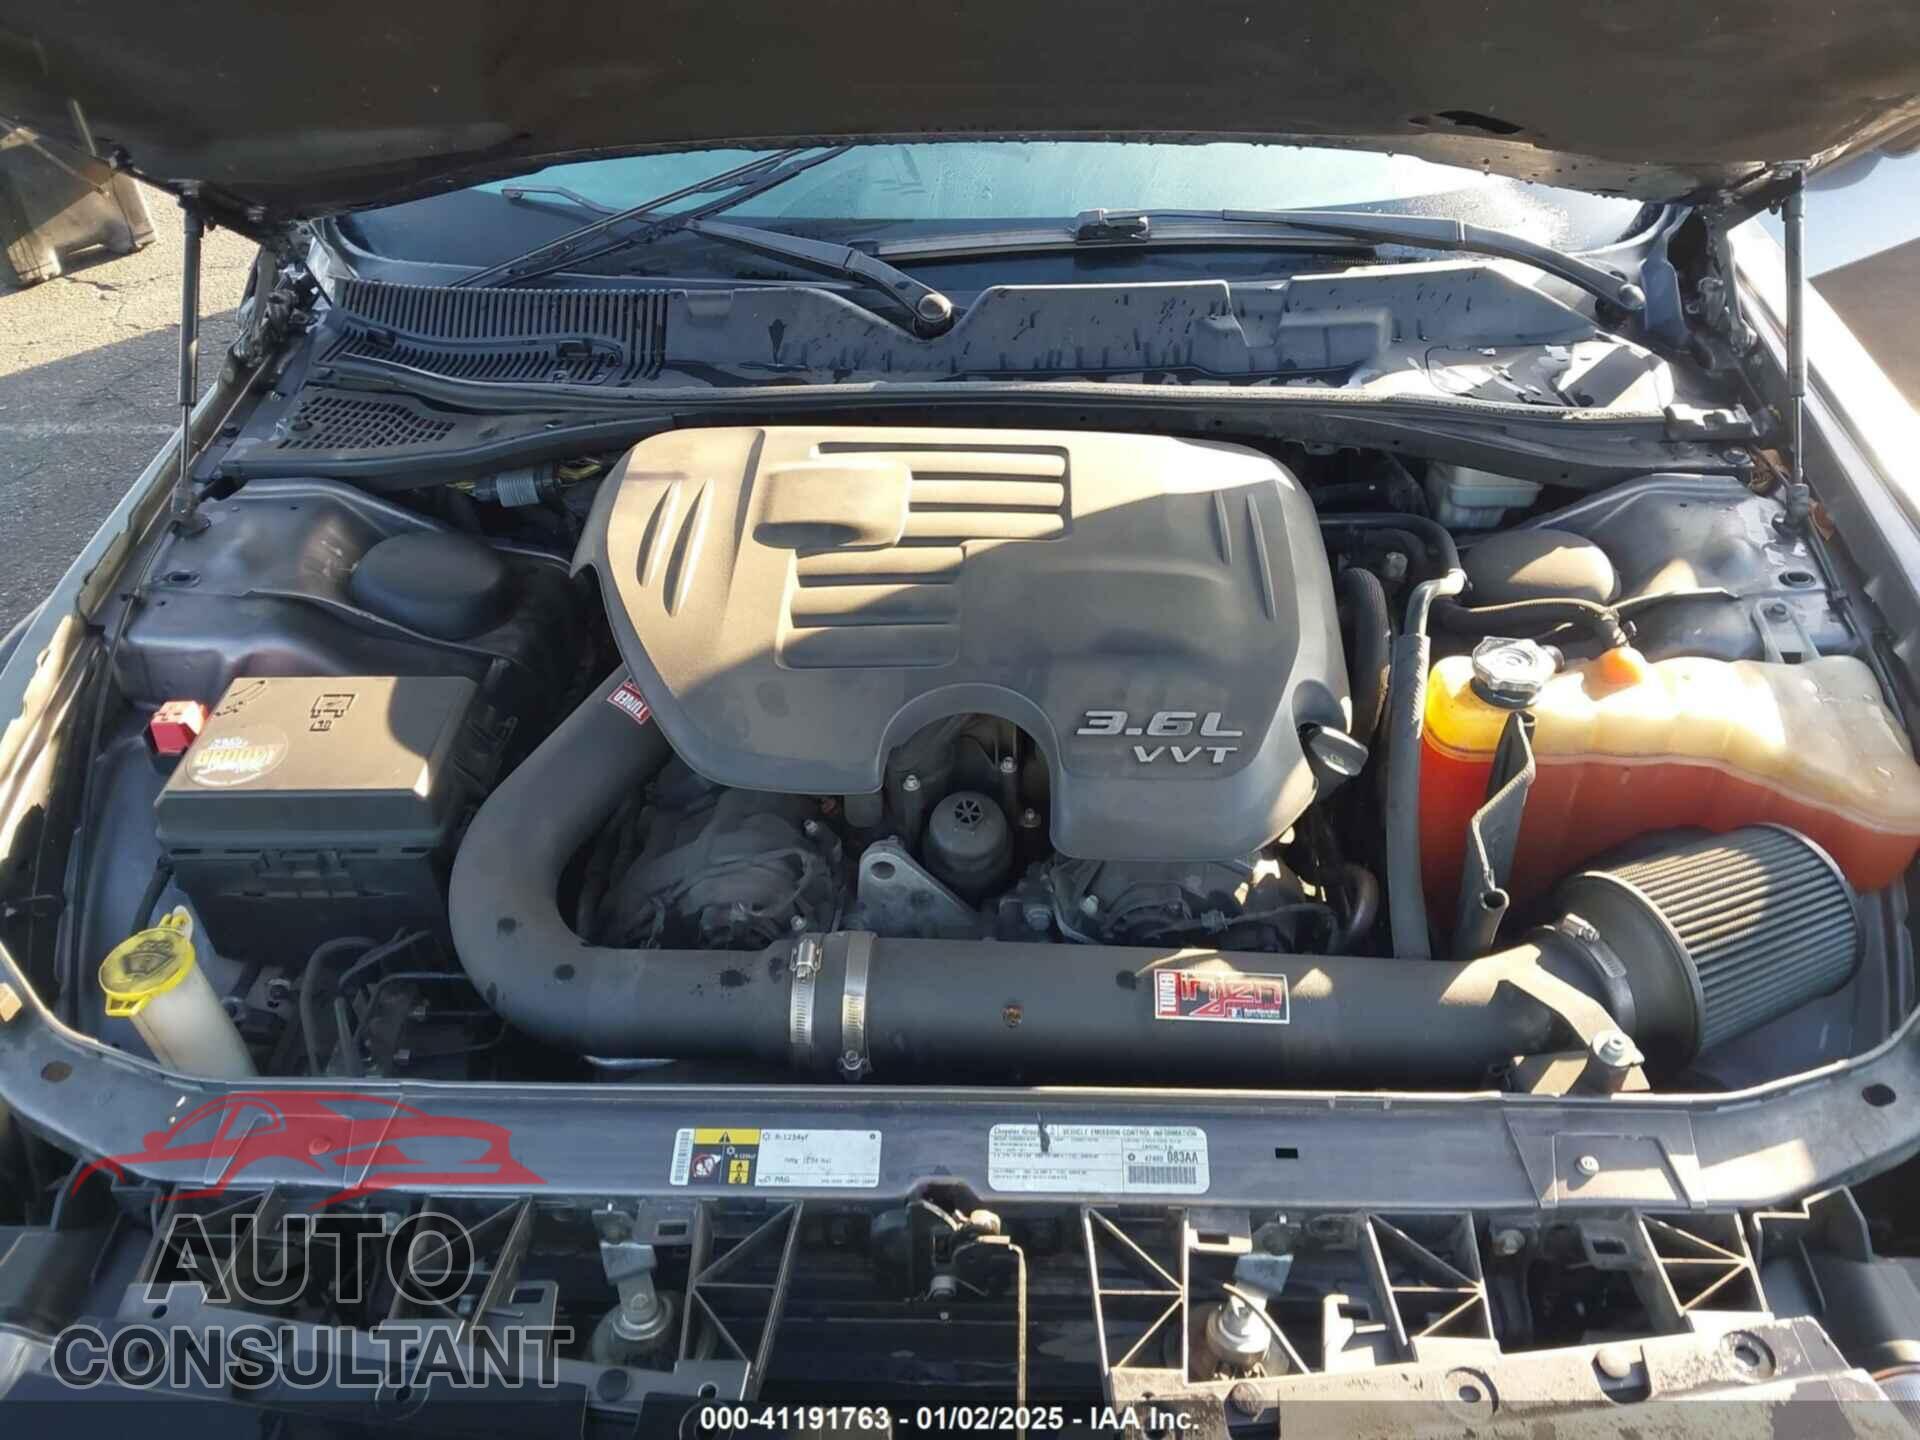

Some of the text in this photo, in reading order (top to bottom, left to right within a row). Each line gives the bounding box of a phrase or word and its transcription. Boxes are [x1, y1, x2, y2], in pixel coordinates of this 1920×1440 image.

[613, 689, 649, 721] TUNED
[1076, 710, 1244, 738] 3.6L
[1133, 745, 1239, 764] VVT
